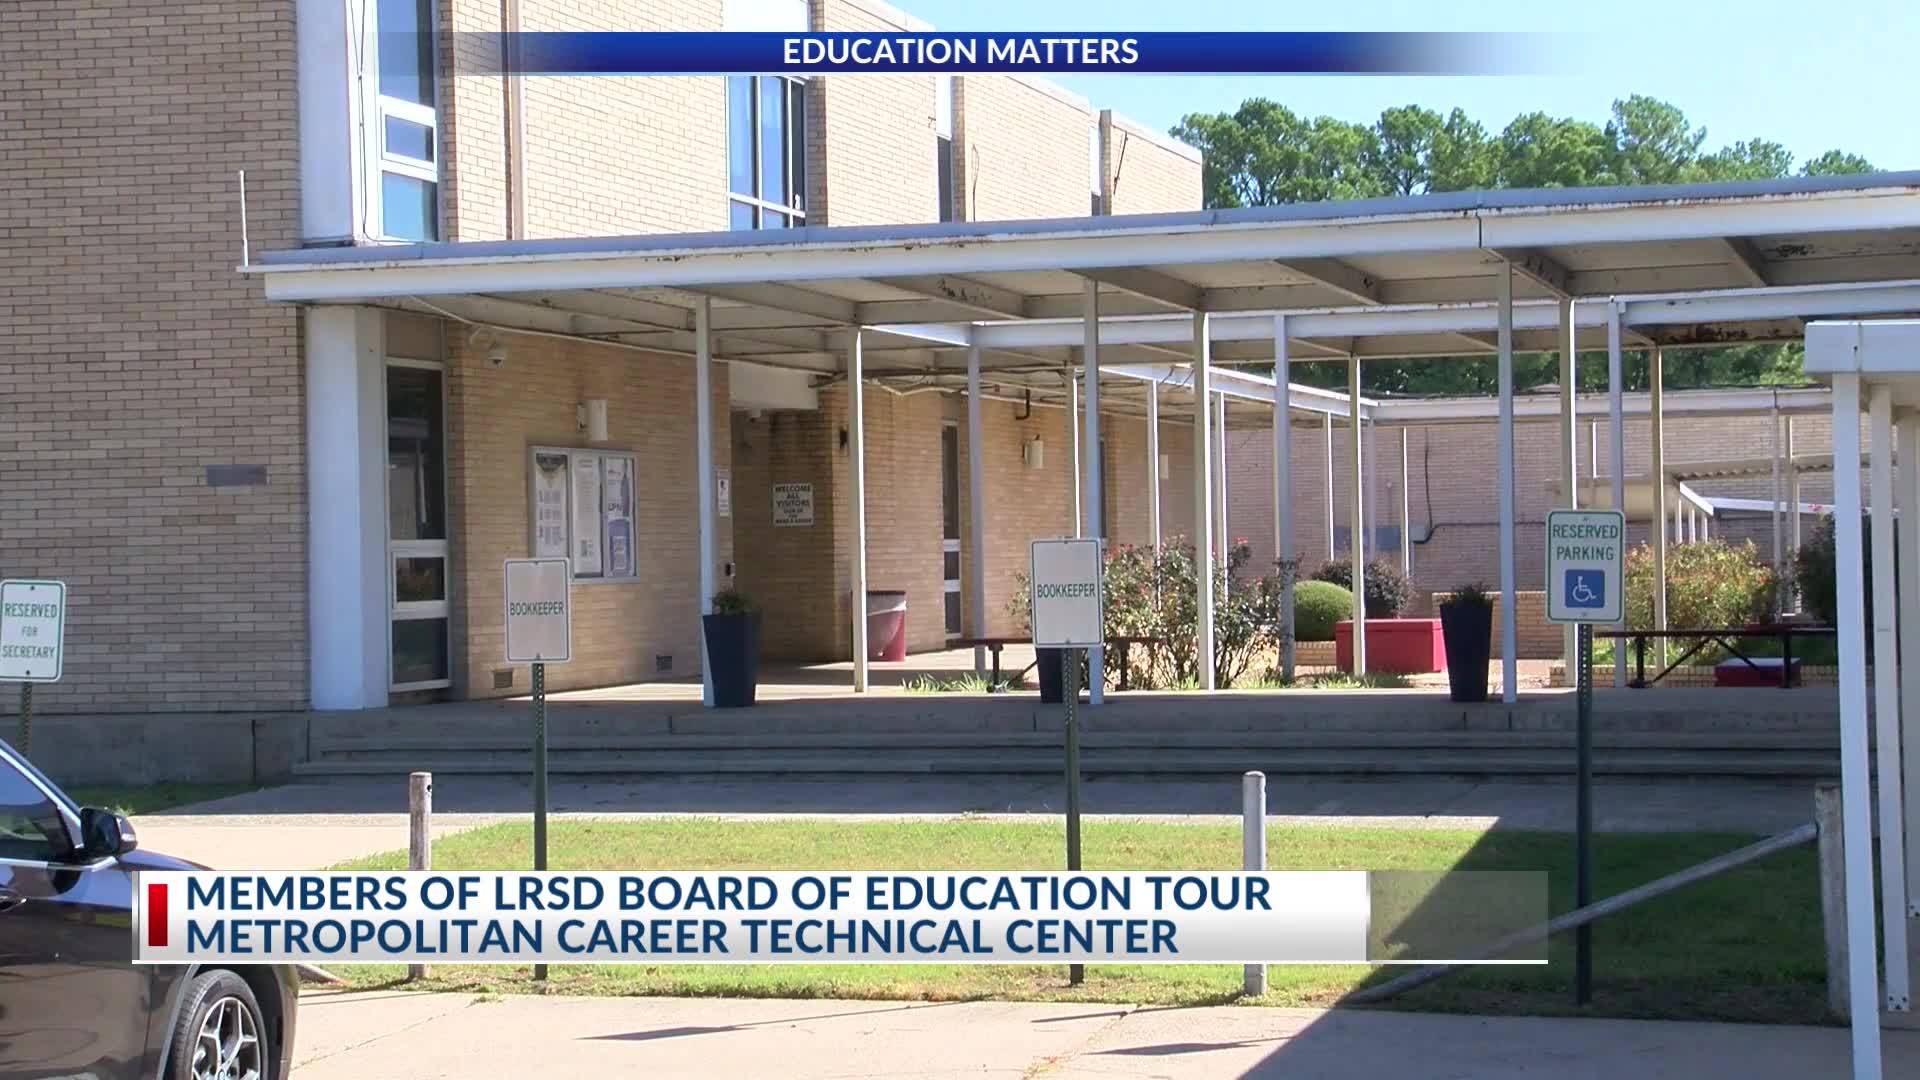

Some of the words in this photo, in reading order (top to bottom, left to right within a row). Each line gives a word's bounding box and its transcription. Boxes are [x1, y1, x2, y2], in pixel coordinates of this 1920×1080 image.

[1552, 524, 1619, 539] RESERVED
[1556, 546, 1614, 561] PARKING
[1037, 583, 1096, 598] BOOKKEEPER
[4, 603, 58, 619] RESERVED
[510, 601, 564, 616] BOOKKEEPER
[22, 624, 38, 637] FOR
[2, 645, 56, 659] SECRETARY
